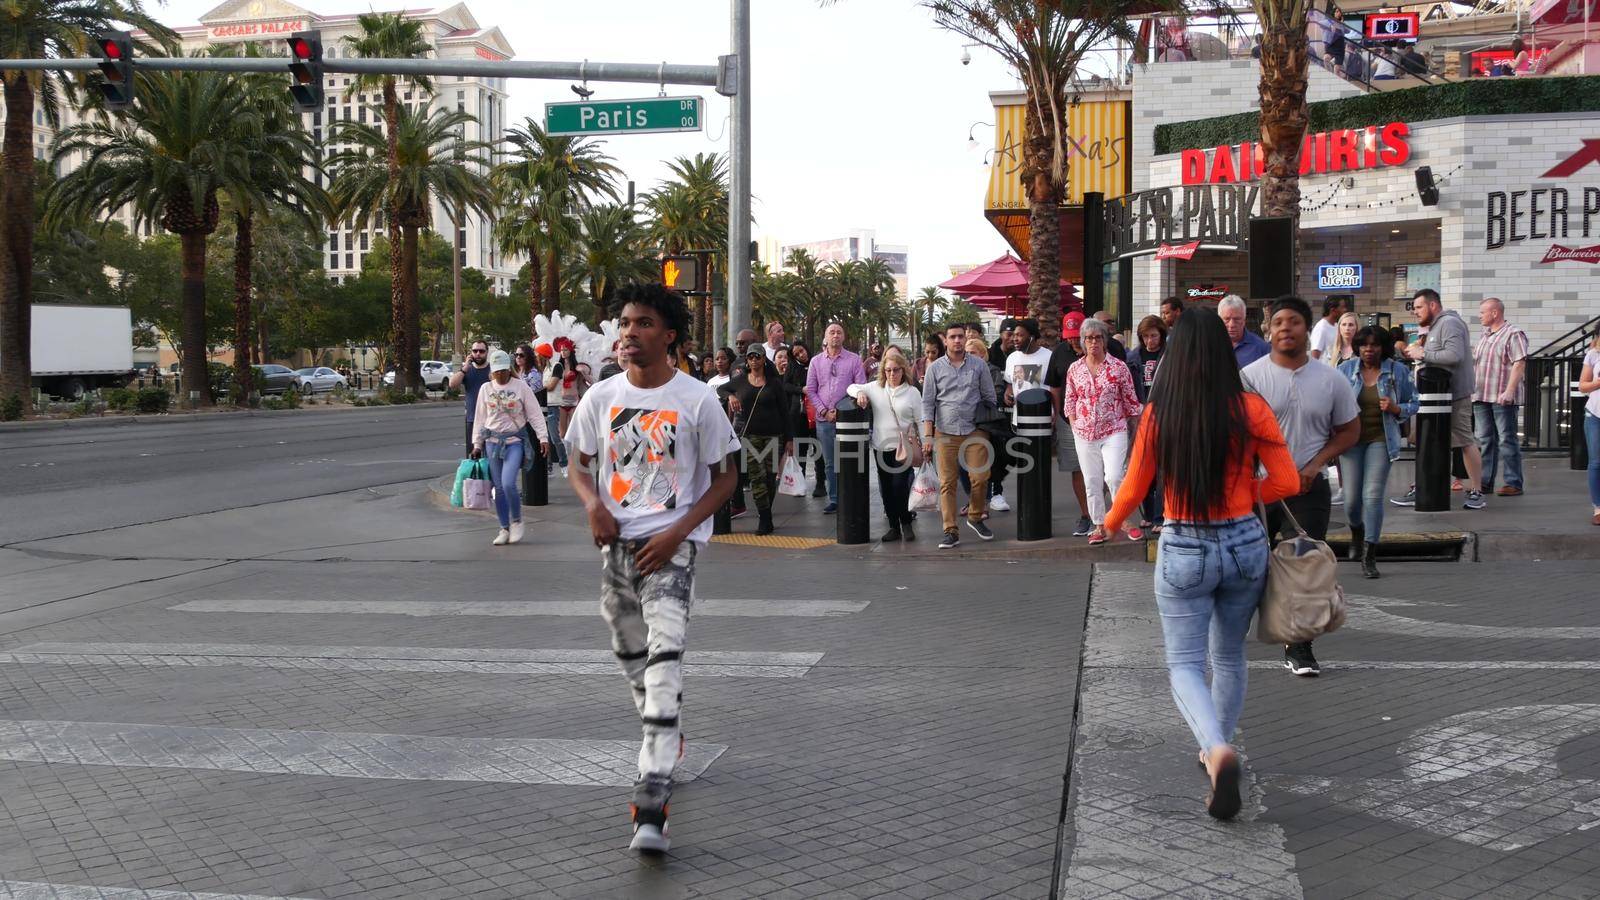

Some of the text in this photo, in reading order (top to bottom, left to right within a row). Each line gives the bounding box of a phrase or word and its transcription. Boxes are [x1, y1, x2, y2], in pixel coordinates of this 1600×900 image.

[213, 20, 302, 37] CAESARS PALACE
[548, 100, 693, 129] E Paris DR
[681, 116, 694, 127] 00
[992, 200, 1027, 209] SANGRIA
[1105, 184, 1261, 259] BEER PARK
[1486, 187, 1568, 250] BEER
[1157, 246, 1195, 257] Budweiser
[1546, 248, 1600, 259] Budweise
[1326, 267, 1355, 277] BUD
[1321, 276, 1359, 286] LIGHT
